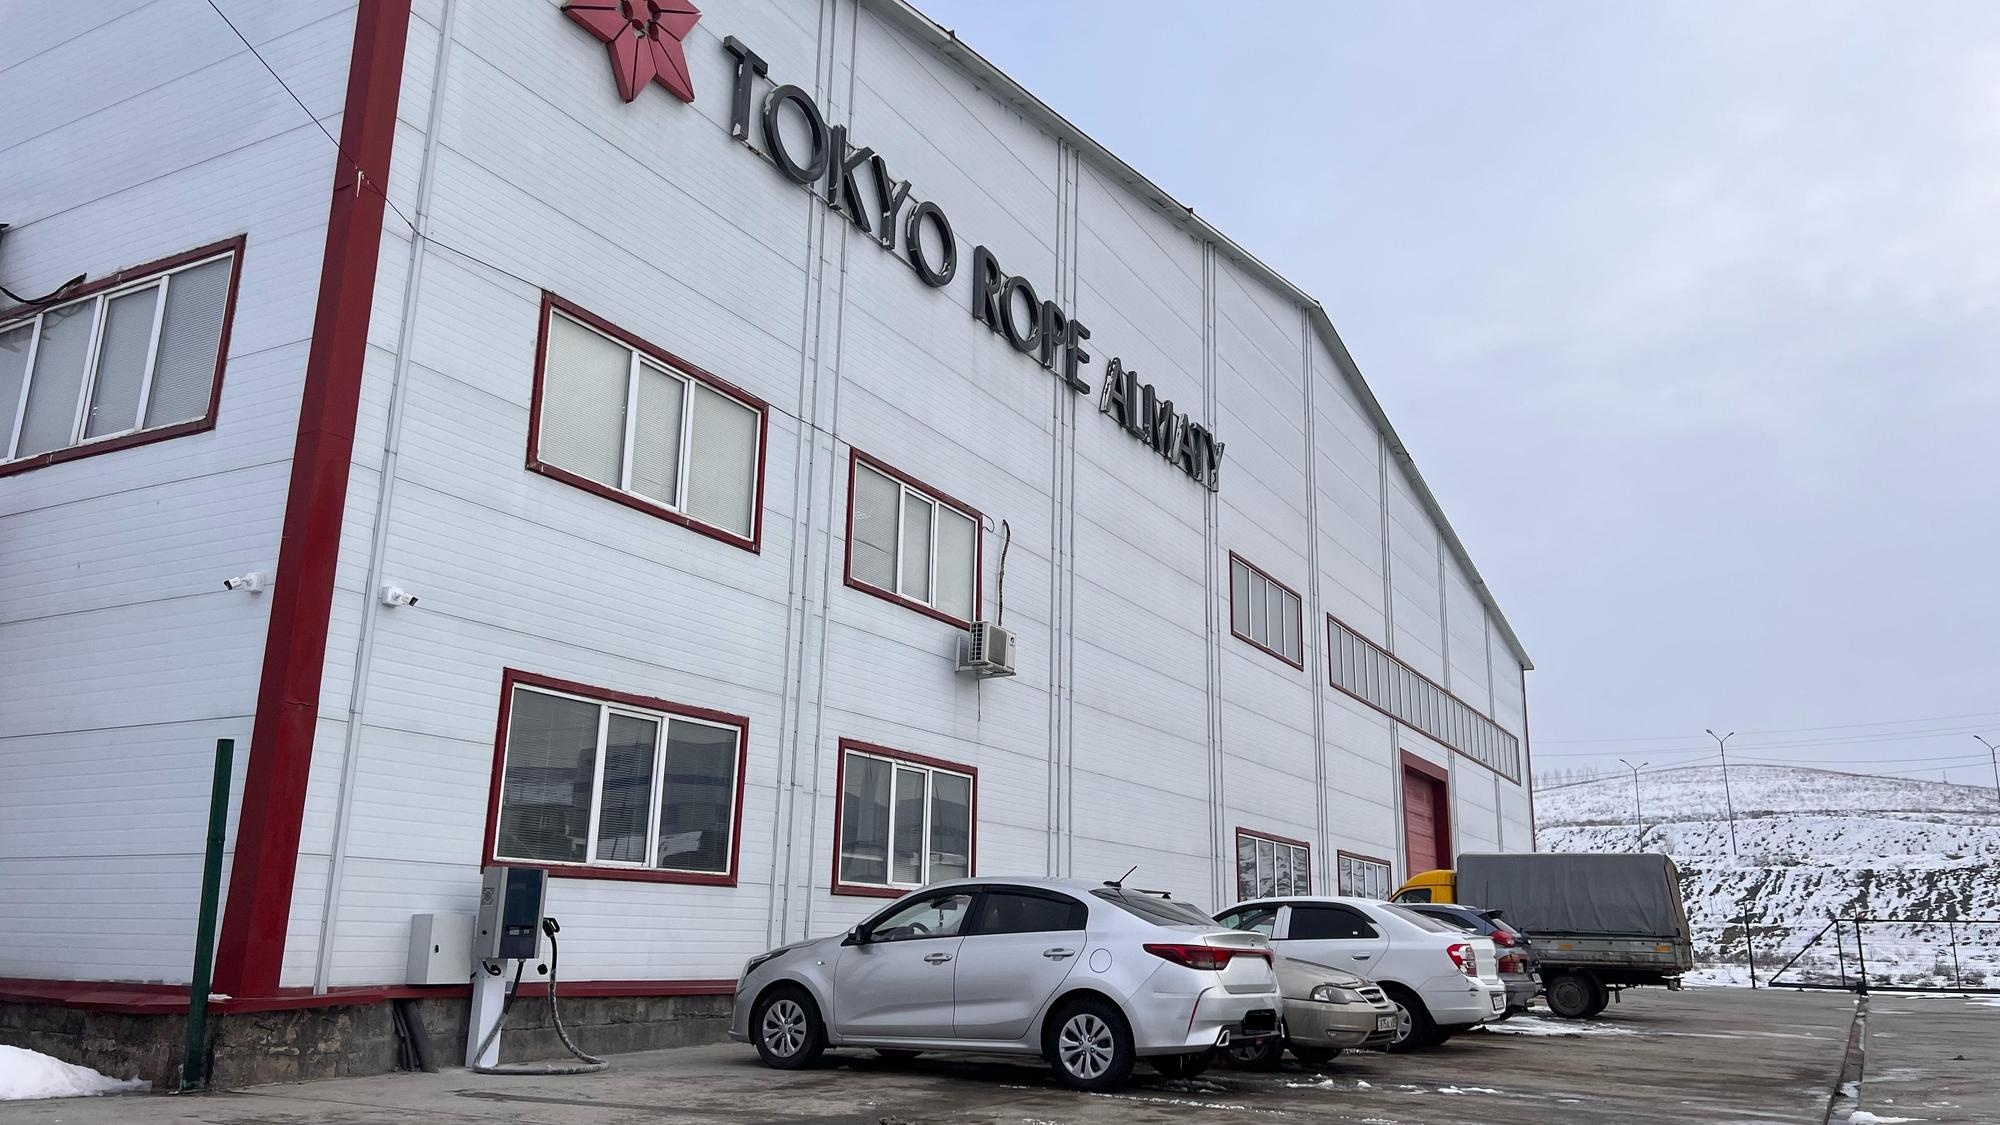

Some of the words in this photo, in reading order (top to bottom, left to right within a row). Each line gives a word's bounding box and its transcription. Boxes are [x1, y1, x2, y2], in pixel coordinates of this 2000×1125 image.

[724, 35, 957, 287] TOKYO
[973, 245, 1090, 394] ROPE
[1100, 357, 1225, 492] ALMATY
